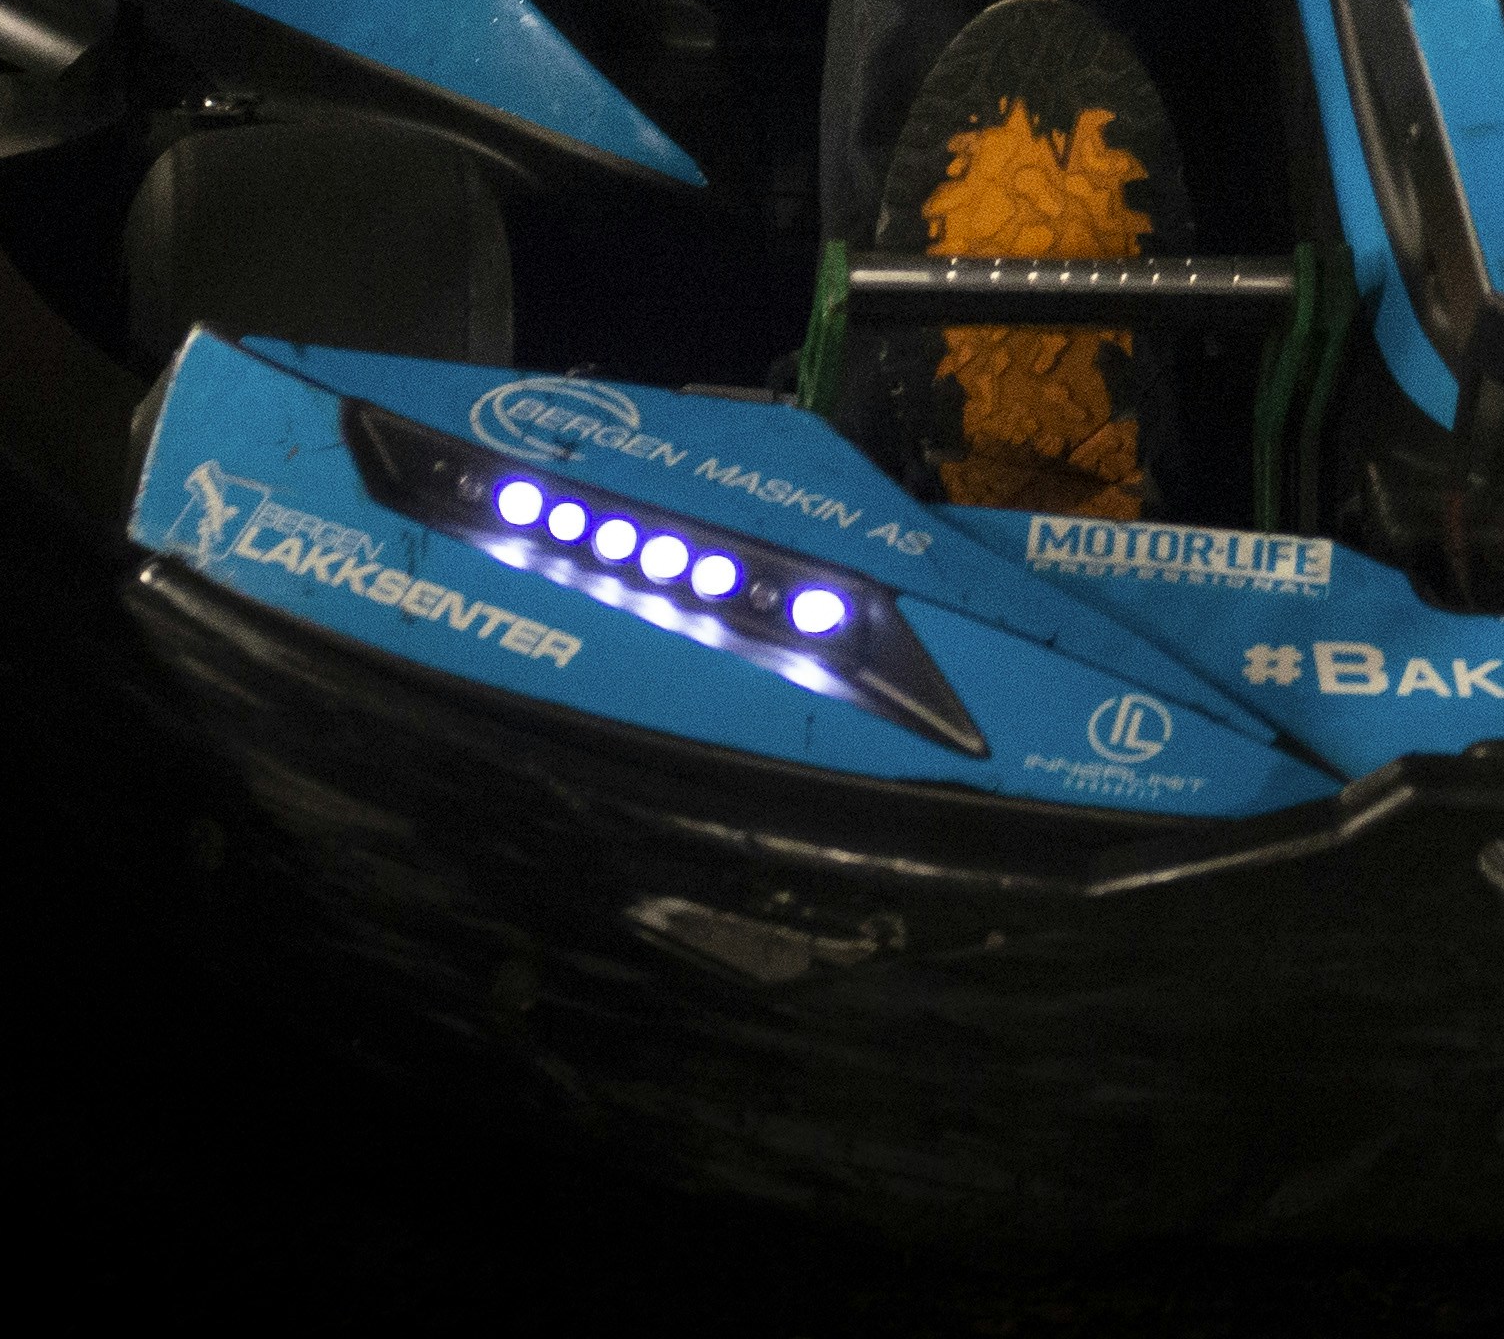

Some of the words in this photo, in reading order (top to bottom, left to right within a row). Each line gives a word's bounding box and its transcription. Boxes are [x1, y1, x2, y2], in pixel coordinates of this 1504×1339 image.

[258, 503, 386, 560] BERGEN
[506, 398, 689, 467] BERGEN
[695, 458, 863, 529] MASKIN
[867, 521, 934, 556] AS
[233, 525, 583, 669] LAKKSENTER
